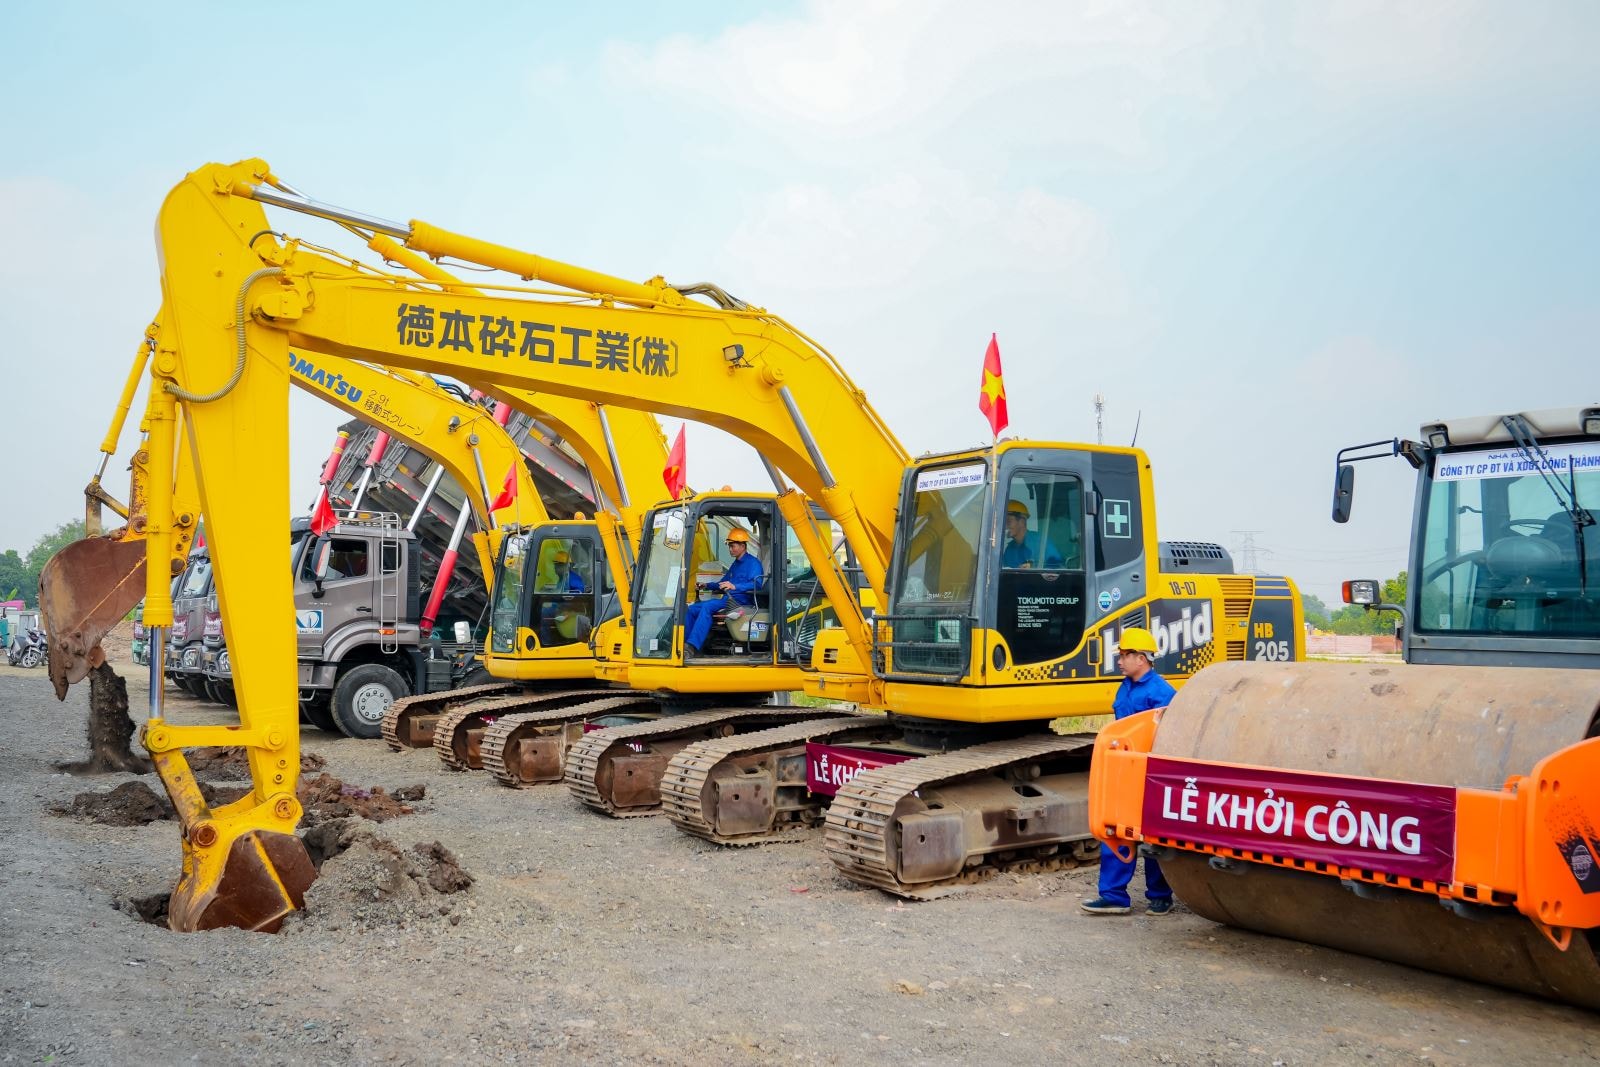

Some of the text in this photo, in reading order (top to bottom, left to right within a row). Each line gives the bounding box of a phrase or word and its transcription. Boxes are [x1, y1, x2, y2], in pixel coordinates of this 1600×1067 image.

[289, 352, 363, 403] OMATSU
[1440, 466, 1463, 477] CÔNG
[1465, 465, 1475, 475] TY
[1477, 464, 1487, 474] CP
[1569, 455, 1600, 468] HÀNH
[1168, 581, 1196, 596] 18-07
[1017, 597, 1079, 605] TOKUMOTO GROUP
[1254, 622, 1274, 639] HB
[1255, 641, 1290, 662] 205
[813, 754, 830, 784] LỄ
[1162, 776, 1421, 855] LỄ KHỞI CÔNG
